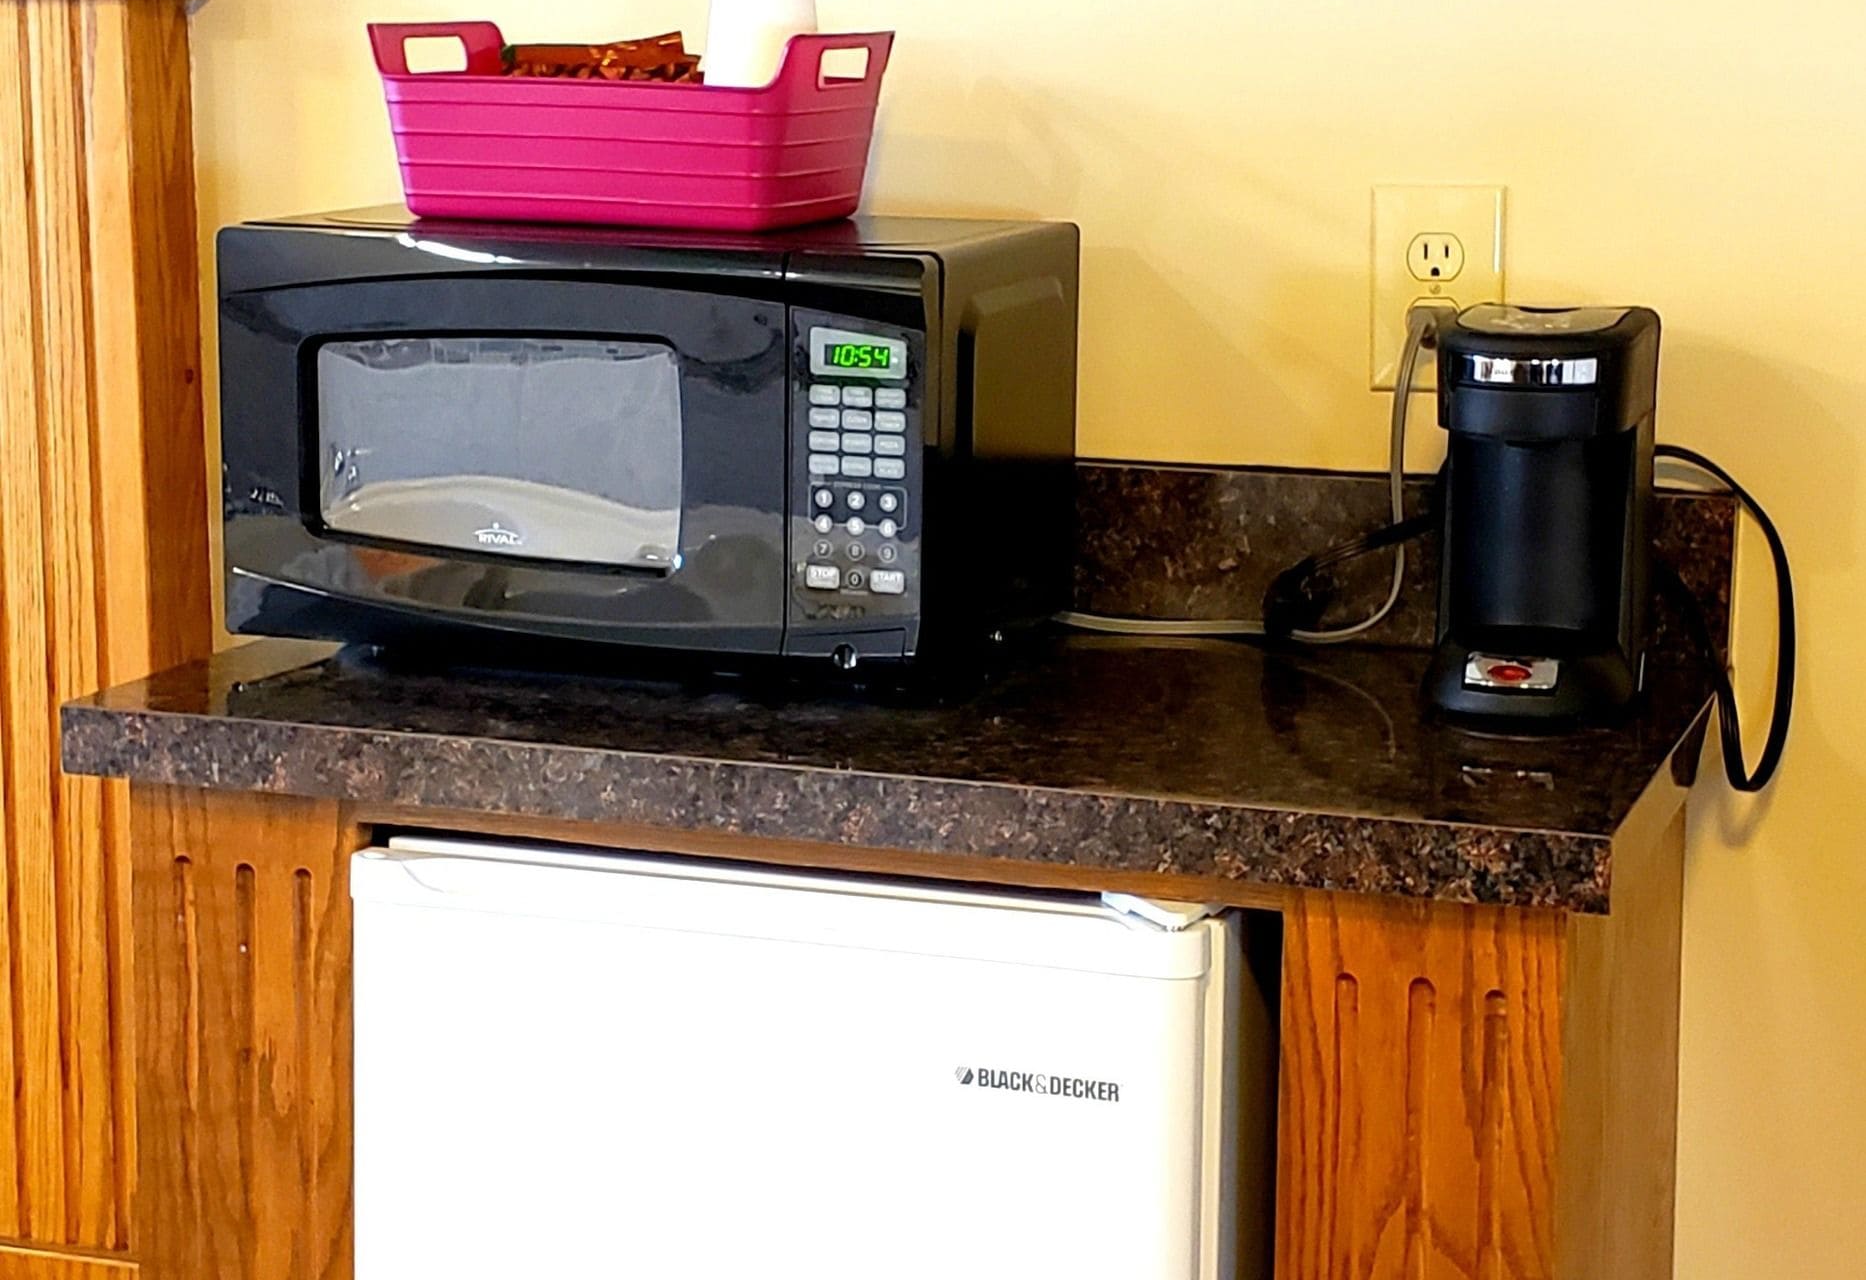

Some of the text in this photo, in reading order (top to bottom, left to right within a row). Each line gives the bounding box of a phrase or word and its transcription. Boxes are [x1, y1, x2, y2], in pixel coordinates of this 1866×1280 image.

[833, 345, 889, 367] 10:54
[478, 533, 516, 545] RIVAL
[809, 565, 837, 579] STOP
[873, 570, 904, 582] START
[978, 1068, 1119, 1102] BLACK&DECKER
